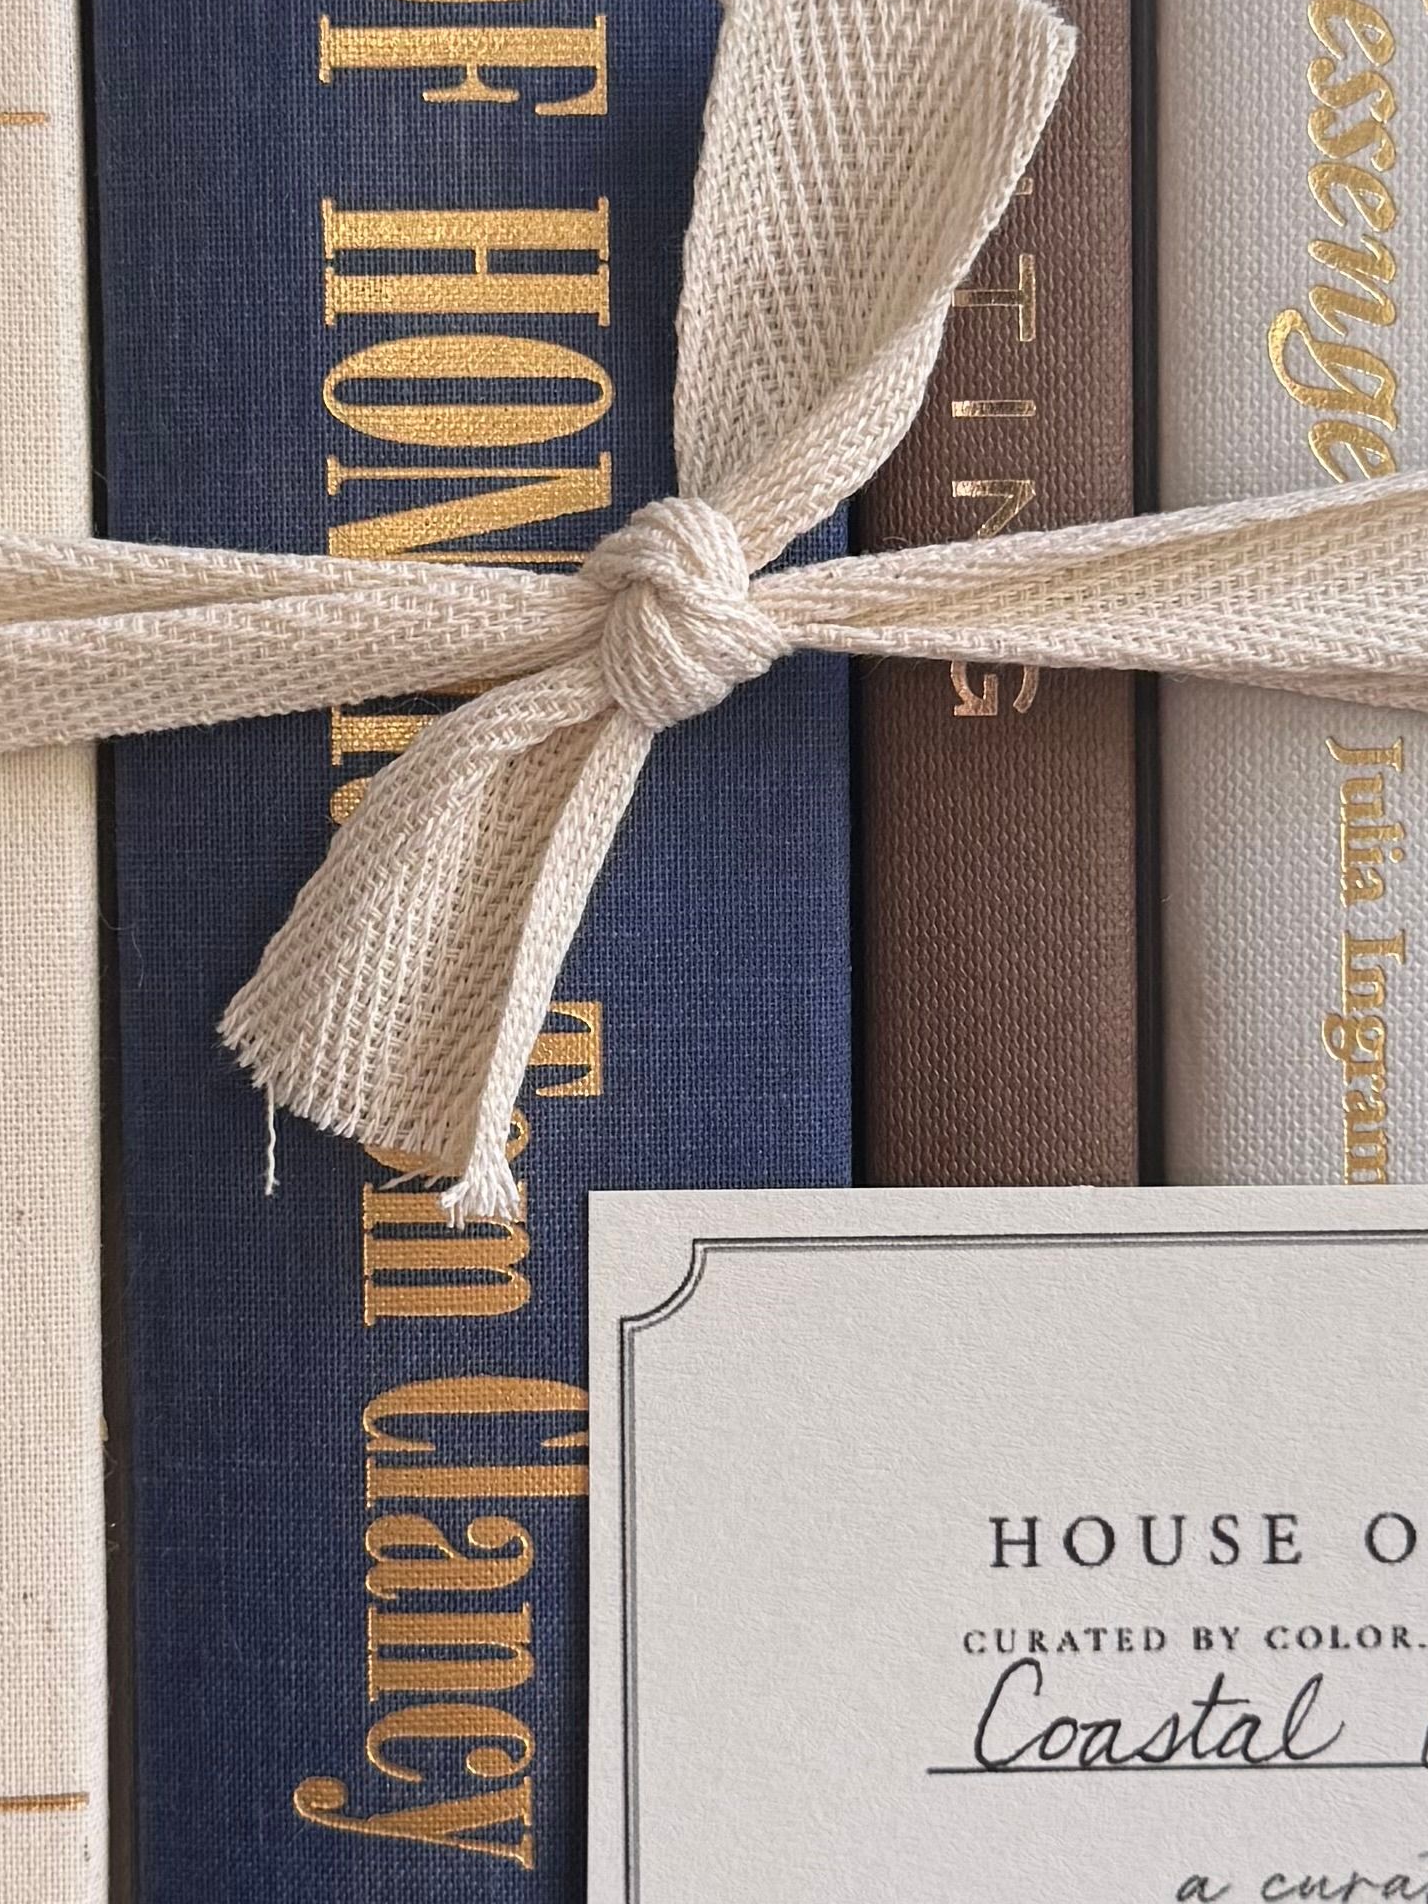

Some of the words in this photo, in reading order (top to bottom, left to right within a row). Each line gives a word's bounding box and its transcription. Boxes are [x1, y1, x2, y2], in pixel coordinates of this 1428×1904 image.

[322, 196, 614, 826] HON
[1325, 736, 1406, 908] Julia
[988, 1511, 1304, 1570] HOUSE
[293, 1374, 591, 1871] Clancy
[962, 1625, 1169, 1657] CURATED
[1192, 1625, 1242, 1654] BY
[974, 1656, 1346, 1770] Coastal
